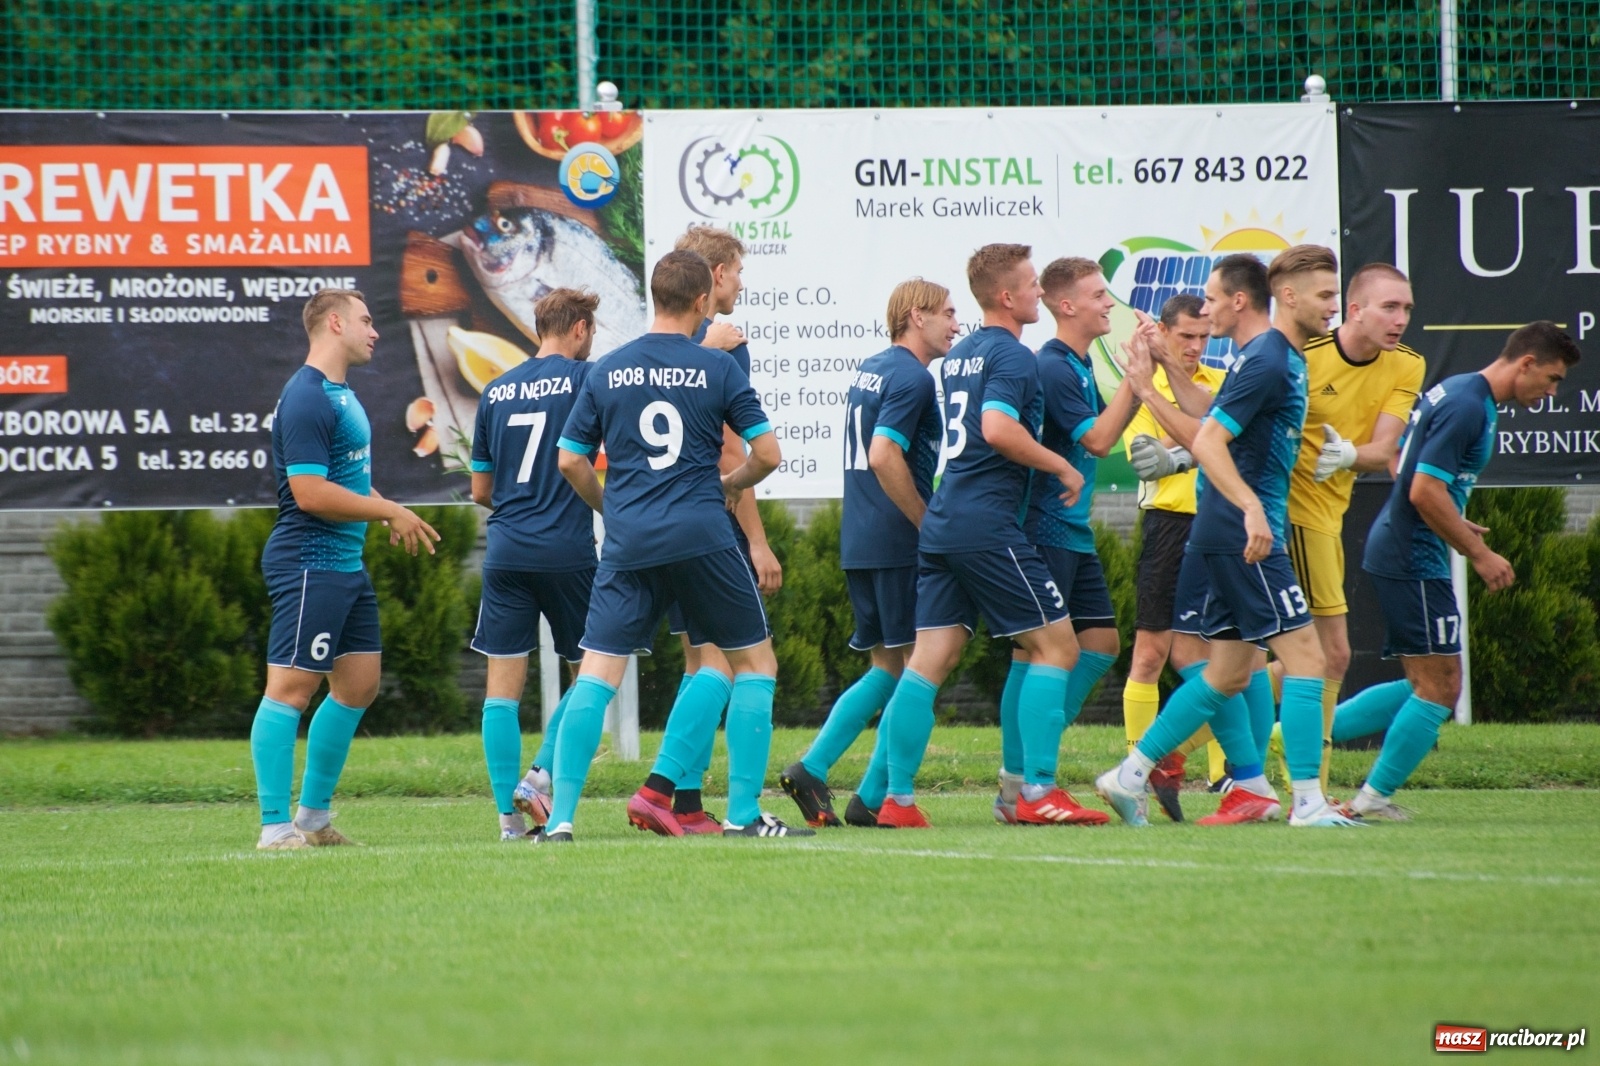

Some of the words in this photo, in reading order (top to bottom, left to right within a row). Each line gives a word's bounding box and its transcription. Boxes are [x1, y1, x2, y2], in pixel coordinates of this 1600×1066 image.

[854, 156, 1042, 187] GM-INSTAL
[1073, 157, 1123, 185] tel.
[1134, 157, 1184, 184] 667
[1194, 156, 1245, 183] 843
[1255, 155, 1308, 181] 022
[855, 197, 924, 218] Marek
[932, 195, 1044, 218] Gawliczek
[37, 234, 132, 255] RYBNY
[149, 234, 169, 254] &
[186, 228, 353, 255] SMAŻALNIA
[6, 273, 103, 302] ŚWIEŻE,
[109, 273, 235, 301] MROŻONE,
[242, 276, 357, 302] WĘDZONE
[796, 287, 837, 306] C.O.
[30, 307, 113, 324] MORSKIE
[129, 306, 270, 323] SŁODKOWODNE
[519, 376, 573, 401] NĘDZA
[608, 367, 645, 389] 1908
[649, 367, 708, 389] NĘDZA
[134, 409, 171, 434] 5A
[190, 413, 227, 433] tel.
[232, 413, 258, 433] 32
[639, 400, 684, 471] 9
[101, 445, 118, 470] 5
[138, 450, 175, 470] tel.
[179, 450, 205, 469] 32
[209, 450, 249, 469] 666
[252, 449, 268, 469] 0
[507, 411, 547, 483] 7
[1045, 580, 1064, 609] 3
[1278, 585, 1308, 618] 13
[1436, 614, 1459, 645] 17
[310, 632, 331, 661] 6
